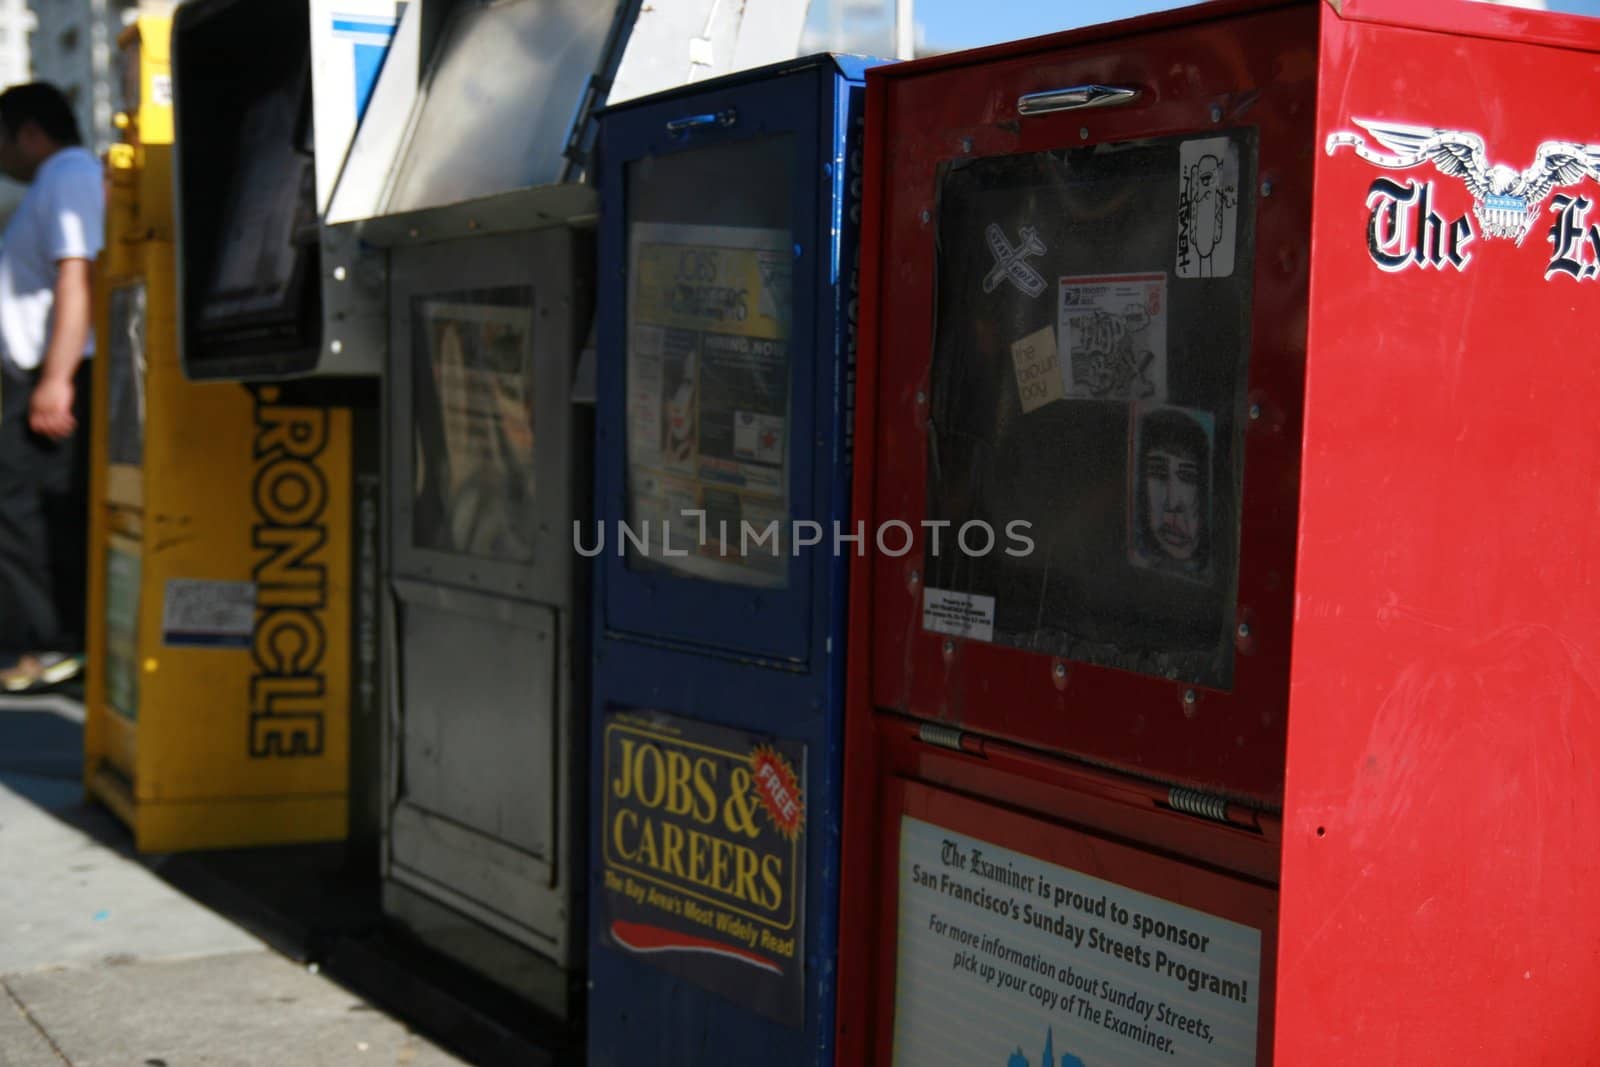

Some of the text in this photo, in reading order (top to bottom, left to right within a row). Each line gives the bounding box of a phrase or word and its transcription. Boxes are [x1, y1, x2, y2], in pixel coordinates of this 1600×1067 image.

[1011, 264, 1039, 288] GOLD
[1366, 177, 1474, 272] The
[247, 382, 330, 760] RONICLE
[613, 738, 760, 839] JOBS &
[758, 761, 798, 823] FREE
[613, 808, 782, 912] CAREERS
[941, 839, 1210, 953] The Examiner is proud to sponsor
[605, 869, 795, 958] The Bay Area's Most Widely Read
[912, 864, 1248, 1003] San Francisco's Sunday Streets Program!
[929, 913, 1215, 1044] For more information about Sunday Streets,
[952, 951, 1175, 1056] pick up your copy of The Examiner.
